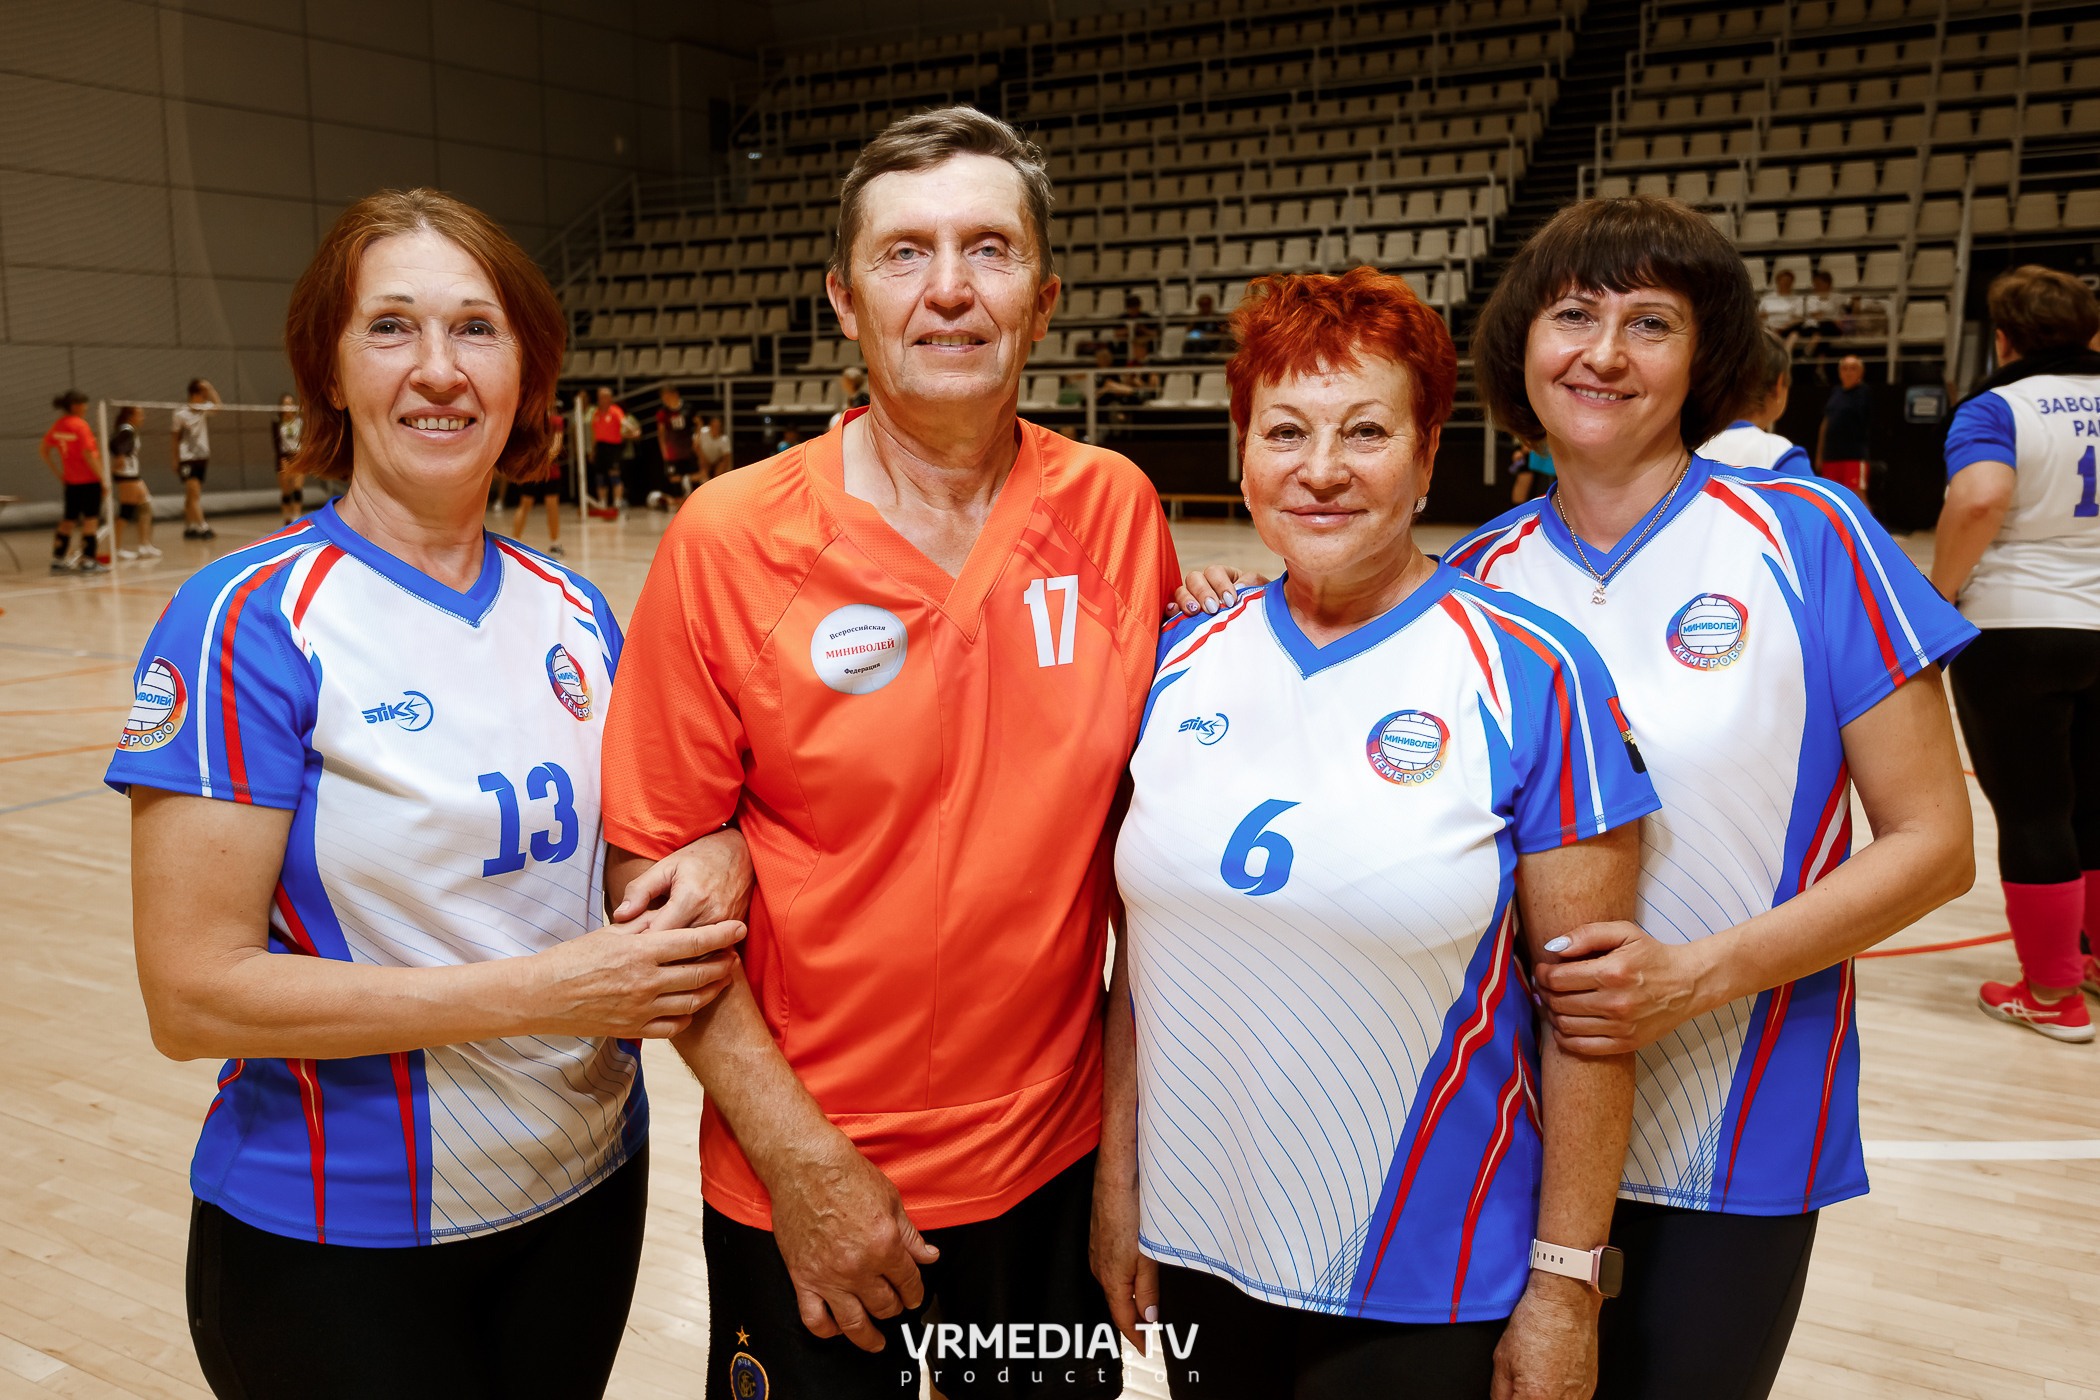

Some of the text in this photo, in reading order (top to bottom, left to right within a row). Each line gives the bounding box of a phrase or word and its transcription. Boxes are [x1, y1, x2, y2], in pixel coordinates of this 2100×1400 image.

[2073, 419, 2100, 437] РА
[2073, 444, 2100, 518] 1
[829, 624, 886, 640] Всероссийская
[1023, 574, 1079, 668] 17
[1683, 620, 1738, 634] МИНИВОЛЕЙ
[825, 638, 895, 659] МИНИВОЛЕЙ
[1673, 640, 1745, 669] КЕМЕРОВО
[844, 662, 881, 675] Федерация
[560, 691, 591, 719] КЕМЕР
[1384, 734, 1438, 749] МИНИВОЛЕЙ
[1370, 751, 1442, 783] КЕМЕРОВО
[477, 761, 580, 878] 13
[1220, 798, 1302, 897] 6
